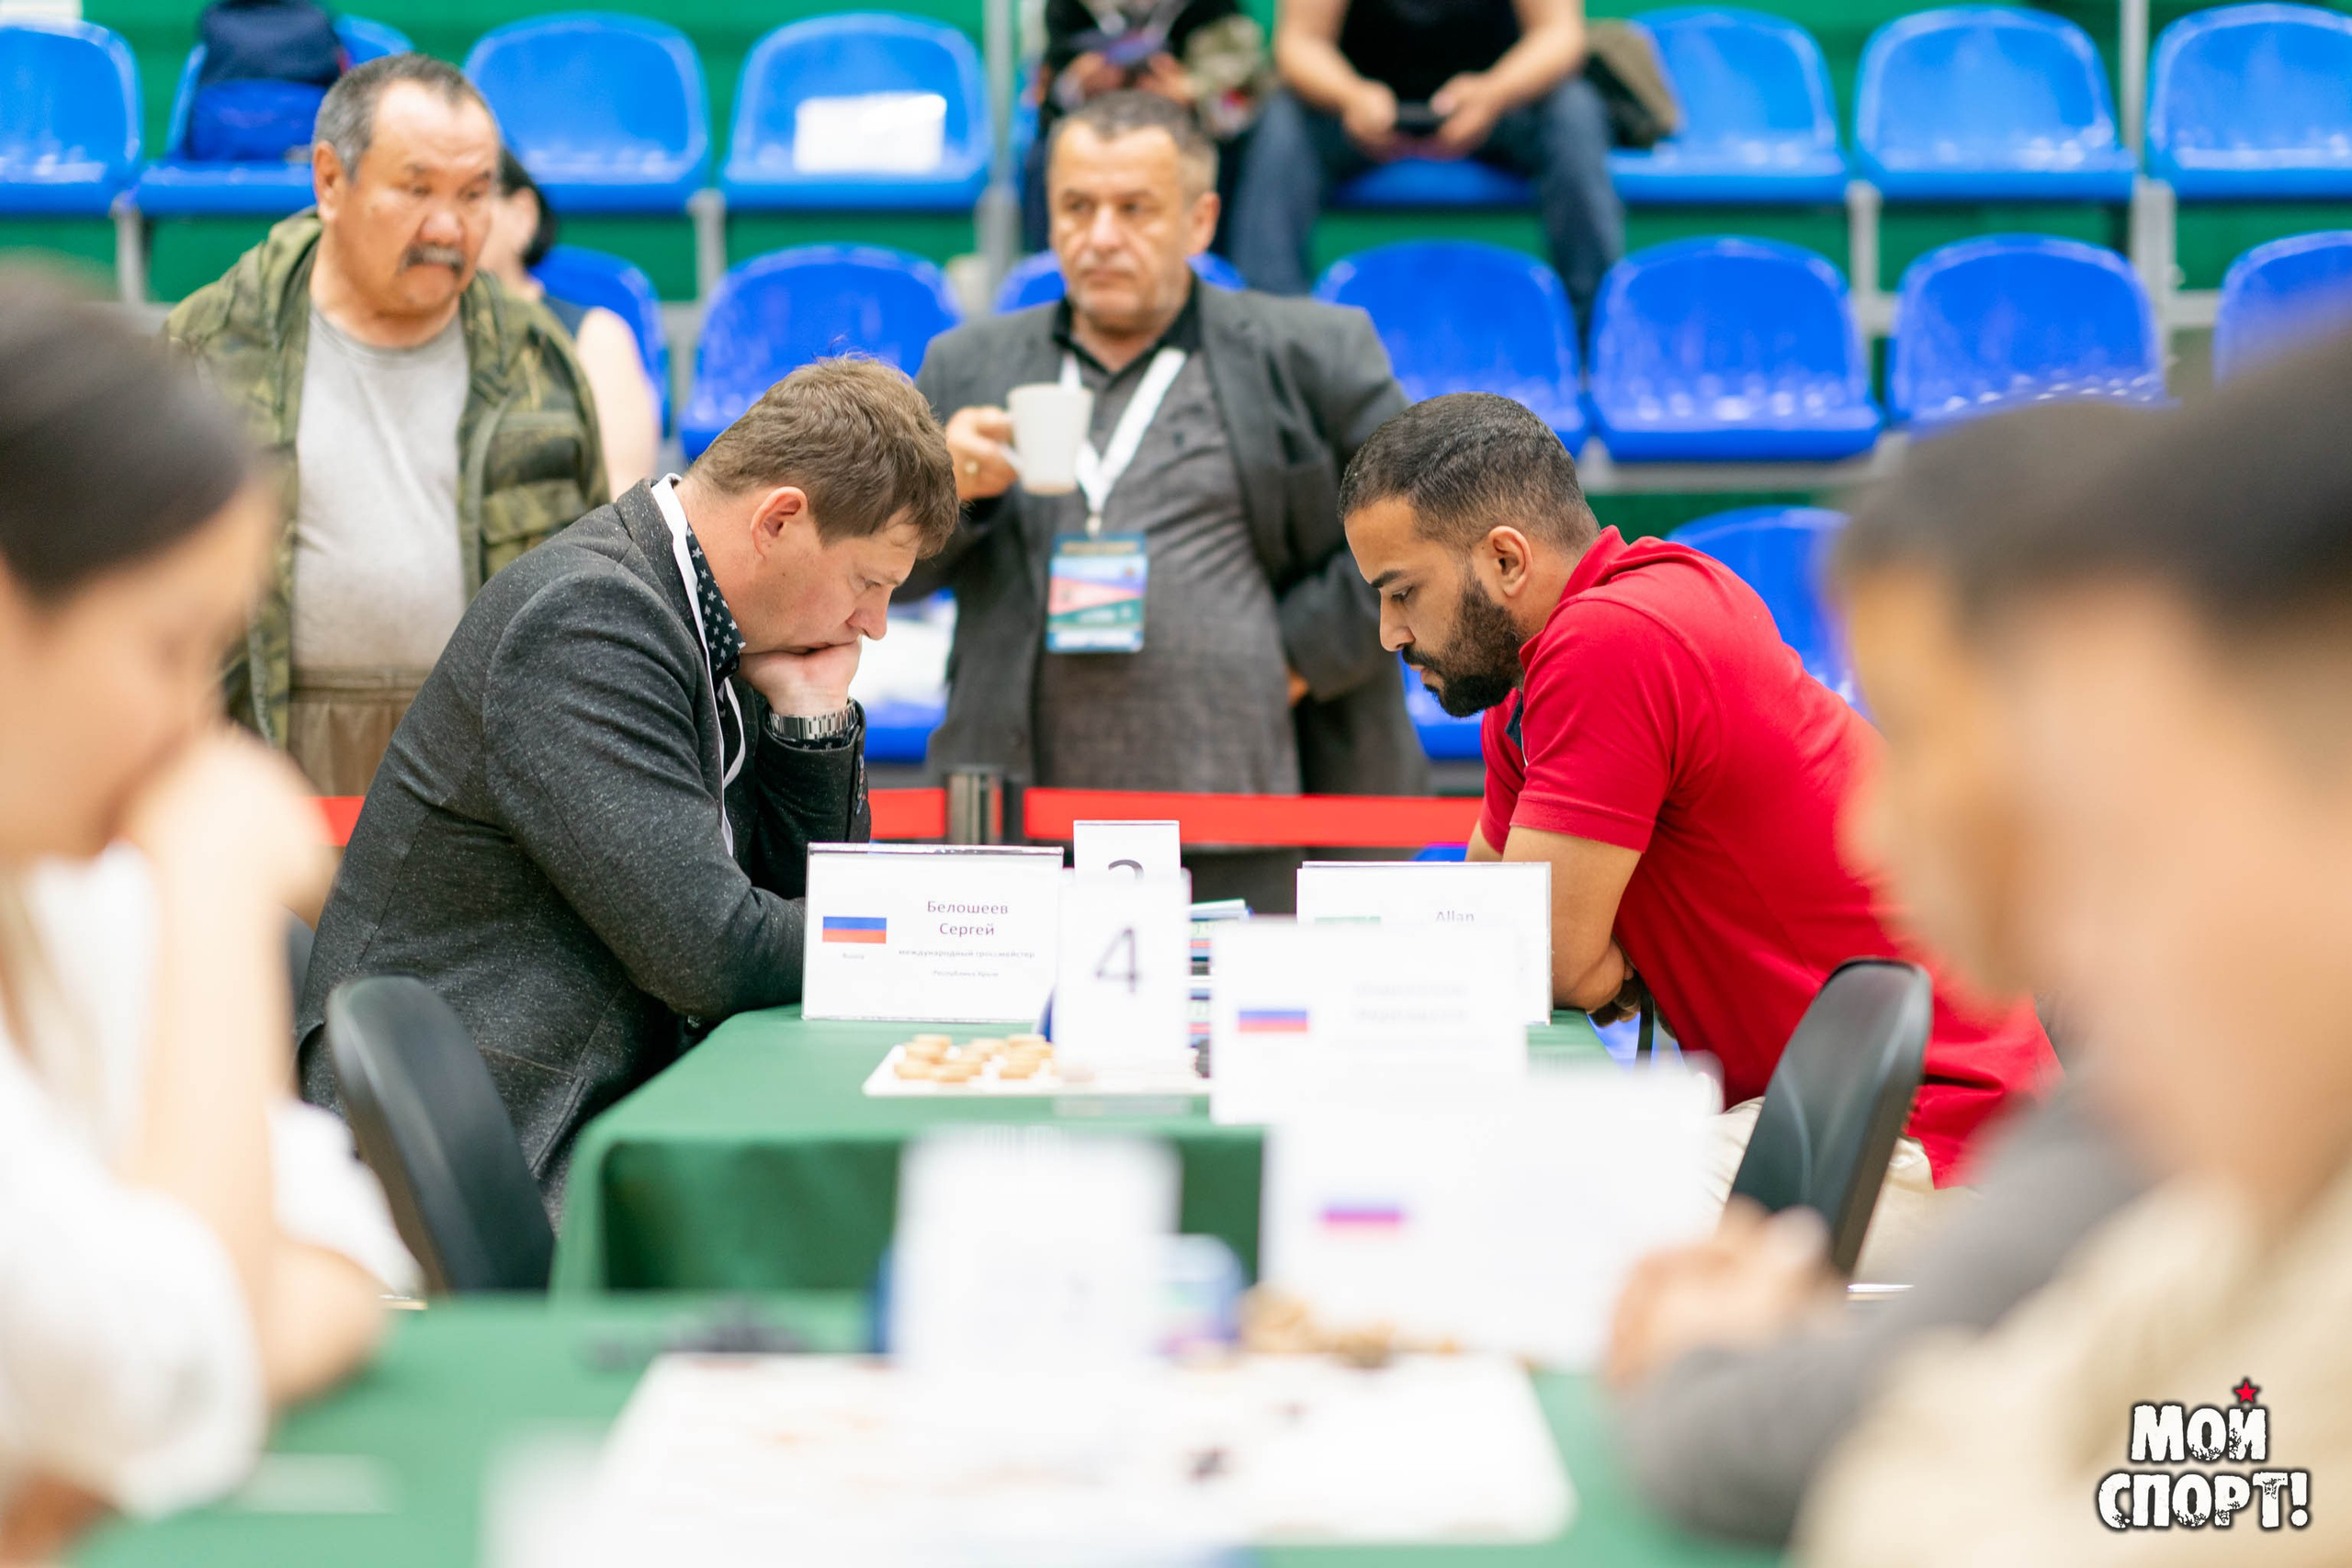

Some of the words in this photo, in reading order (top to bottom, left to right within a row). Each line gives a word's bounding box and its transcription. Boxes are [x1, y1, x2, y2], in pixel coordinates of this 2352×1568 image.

[927, 900, 1009, 915] Белошеев
[1435, 909, 1475, 923] Allan
[939, 922, 995, 938] Сергей
[1094, 926, 1139, 994] 4
